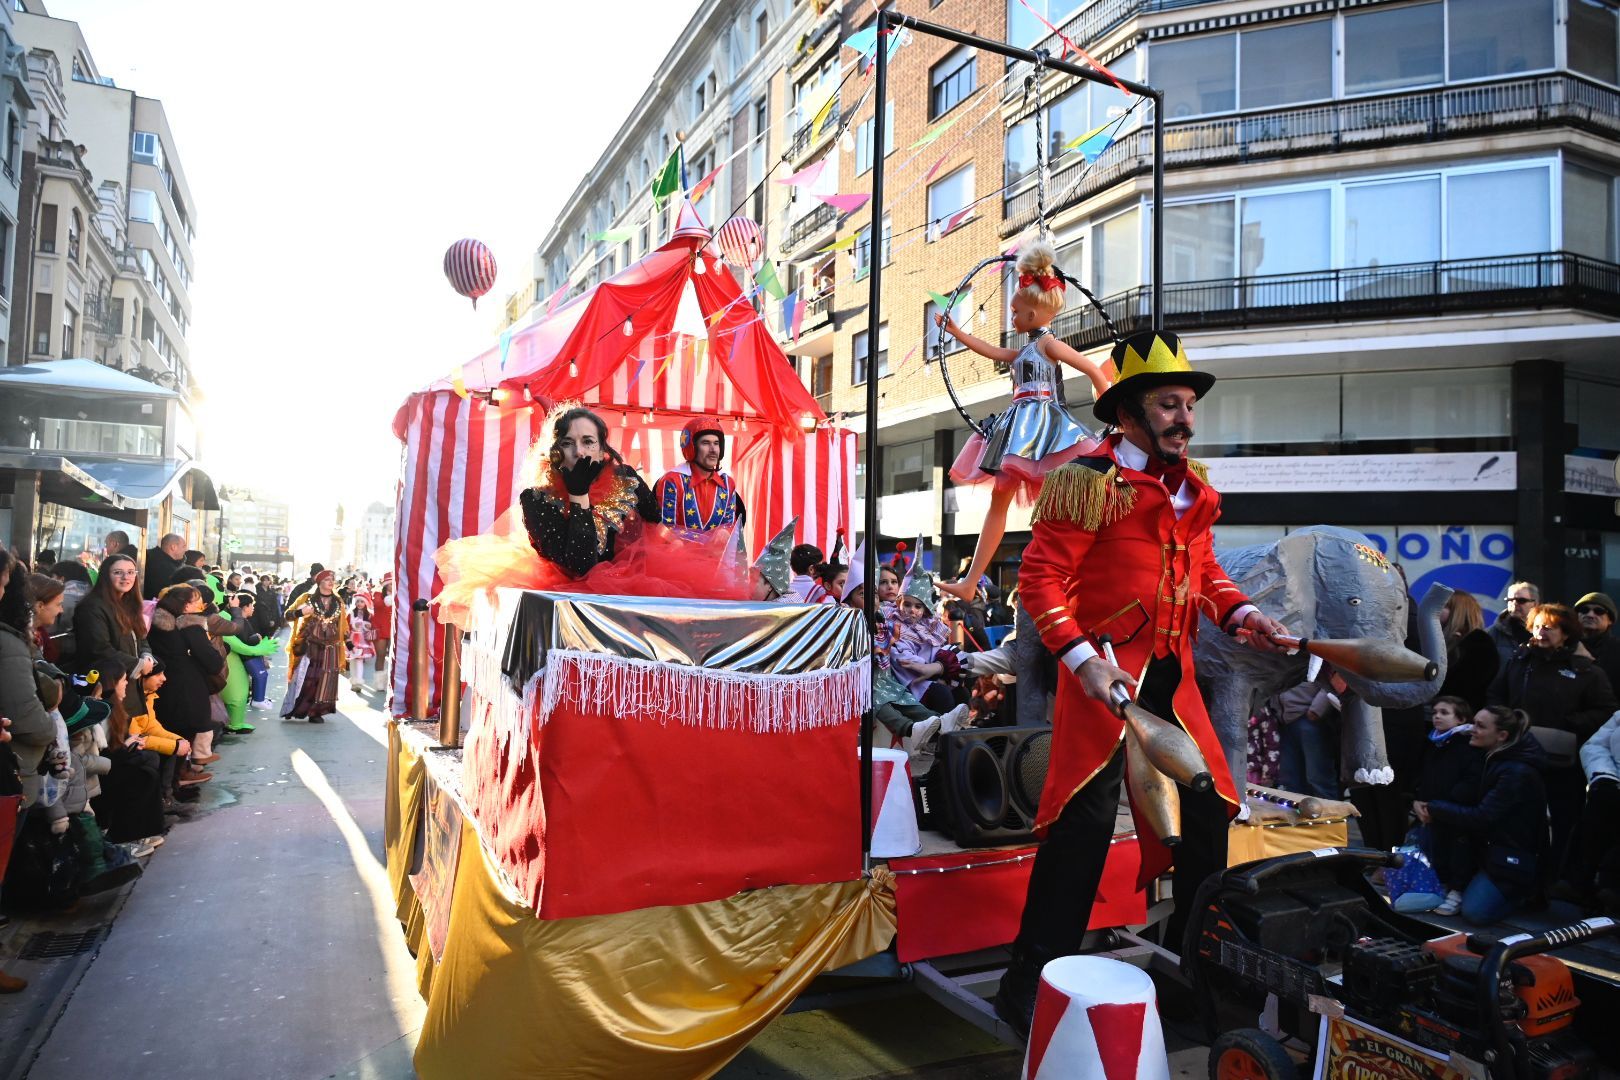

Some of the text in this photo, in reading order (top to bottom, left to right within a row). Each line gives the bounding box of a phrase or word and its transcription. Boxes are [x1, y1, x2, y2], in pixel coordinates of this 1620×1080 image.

[279, 536, 288, 547] P
[1366, 1040, 1424, 1074] EL GRAN
